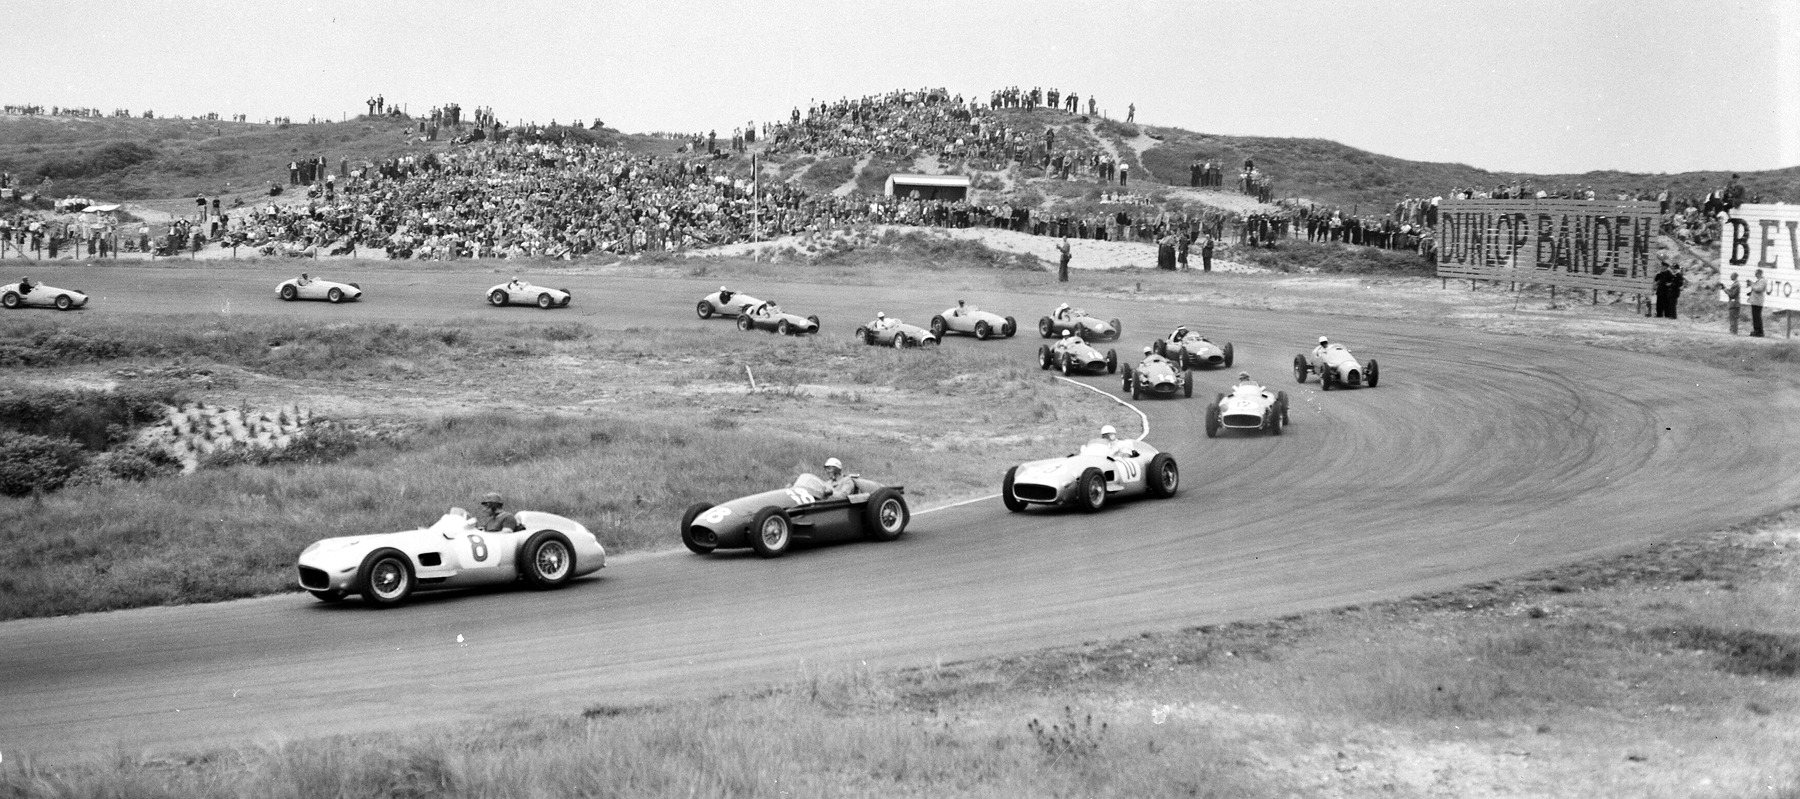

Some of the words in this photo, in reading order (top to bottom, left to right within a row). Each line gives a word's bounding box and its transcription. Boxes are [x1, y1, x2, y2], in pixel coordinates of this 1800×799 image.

[1441, 211, 1529, 269] DUNLOP
[1536, 213, 1651, 279] BANDEN
[1114, 456, 1137, 480] 10
[466, 534, 489, 562] 8
